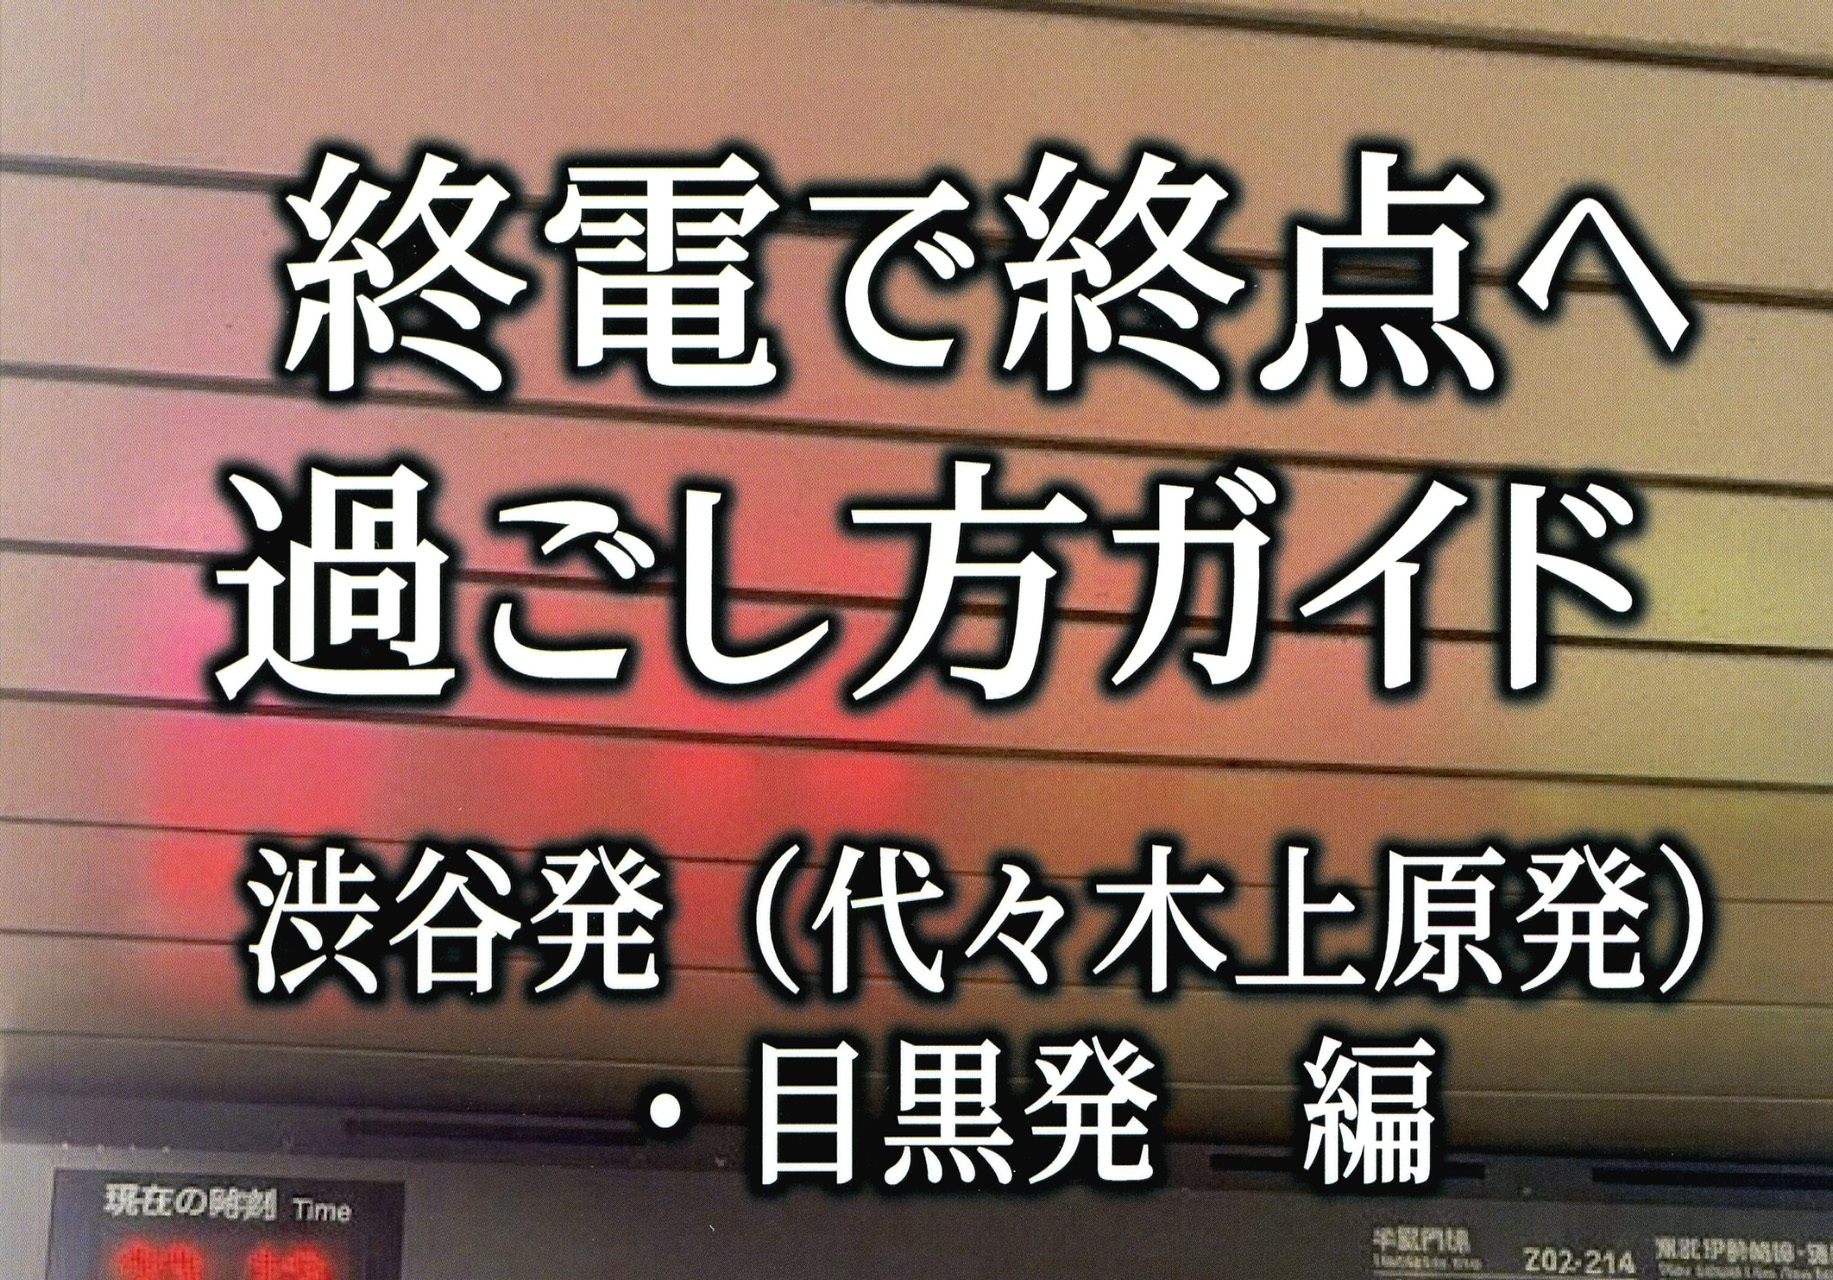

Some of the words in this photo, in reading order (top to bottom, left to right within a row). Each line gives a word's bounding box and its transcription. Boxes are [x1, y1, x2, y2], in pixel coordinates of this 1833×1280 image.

[104, 1183, 277, 1221] 現在の時刻
[293, 1197, 352, 1223] Time
